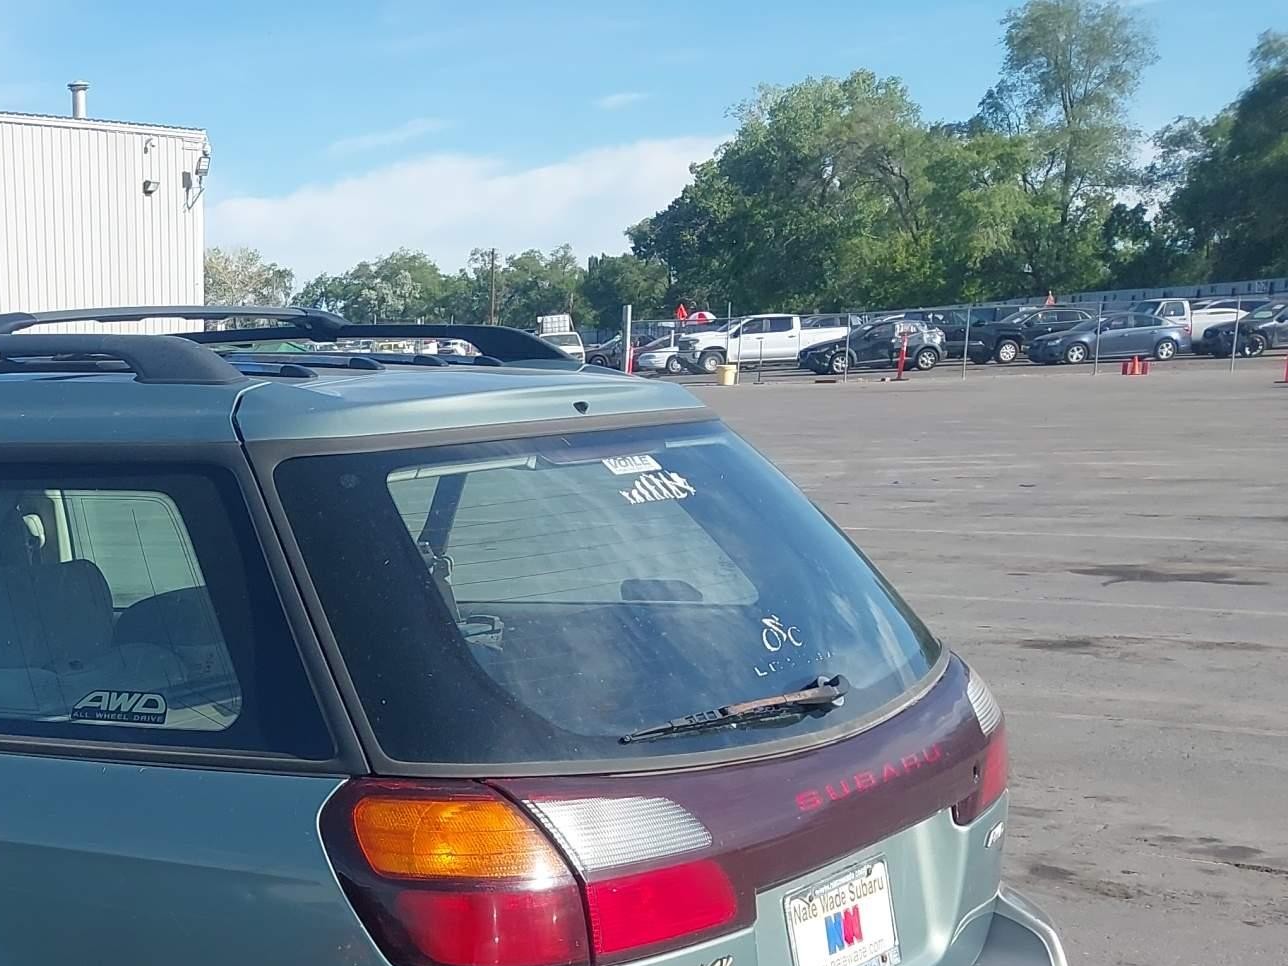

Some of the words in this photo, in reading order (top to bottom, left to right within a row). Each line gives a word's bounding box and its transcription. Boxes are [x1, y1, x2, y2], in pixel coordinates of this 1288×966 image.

[73, 711, 90, 719] ALL
[95, 711, 129, 721] WHEEL
[133, 713, 164, 724] DRIVE
[74, 691, 166, 714] AWD
[795, 743, 943, 812] SUBARU
[793, 901, 818, 925] Nate
[819, 889, 846, 915] Wade
[847, 875, 884, 902] Subaru
